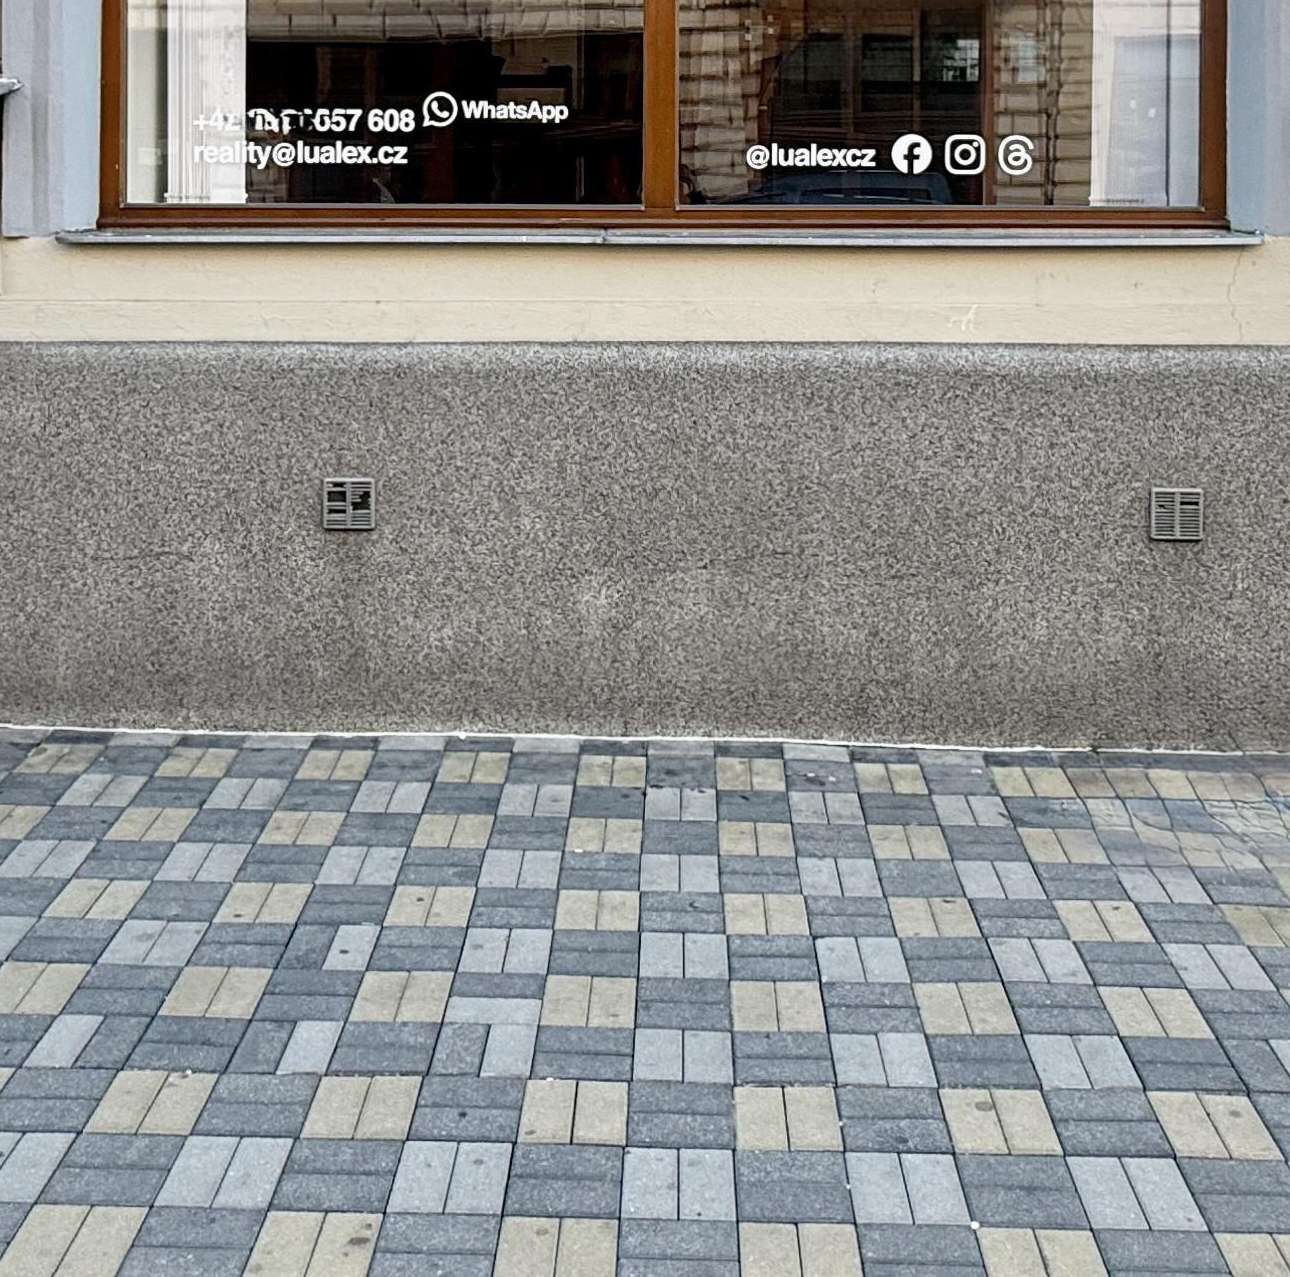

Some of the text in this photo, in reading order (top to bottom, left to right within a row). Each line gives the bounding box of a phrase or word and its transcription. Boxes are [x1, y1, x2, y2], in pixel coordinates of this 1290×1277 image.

[367, 108, 416, 132] 608
[462, 100, 568, 123] WhatsApp
[194, 140, 408, 169] reality@lualex.cz
[745, 142, 876, 170] @lualexcz
